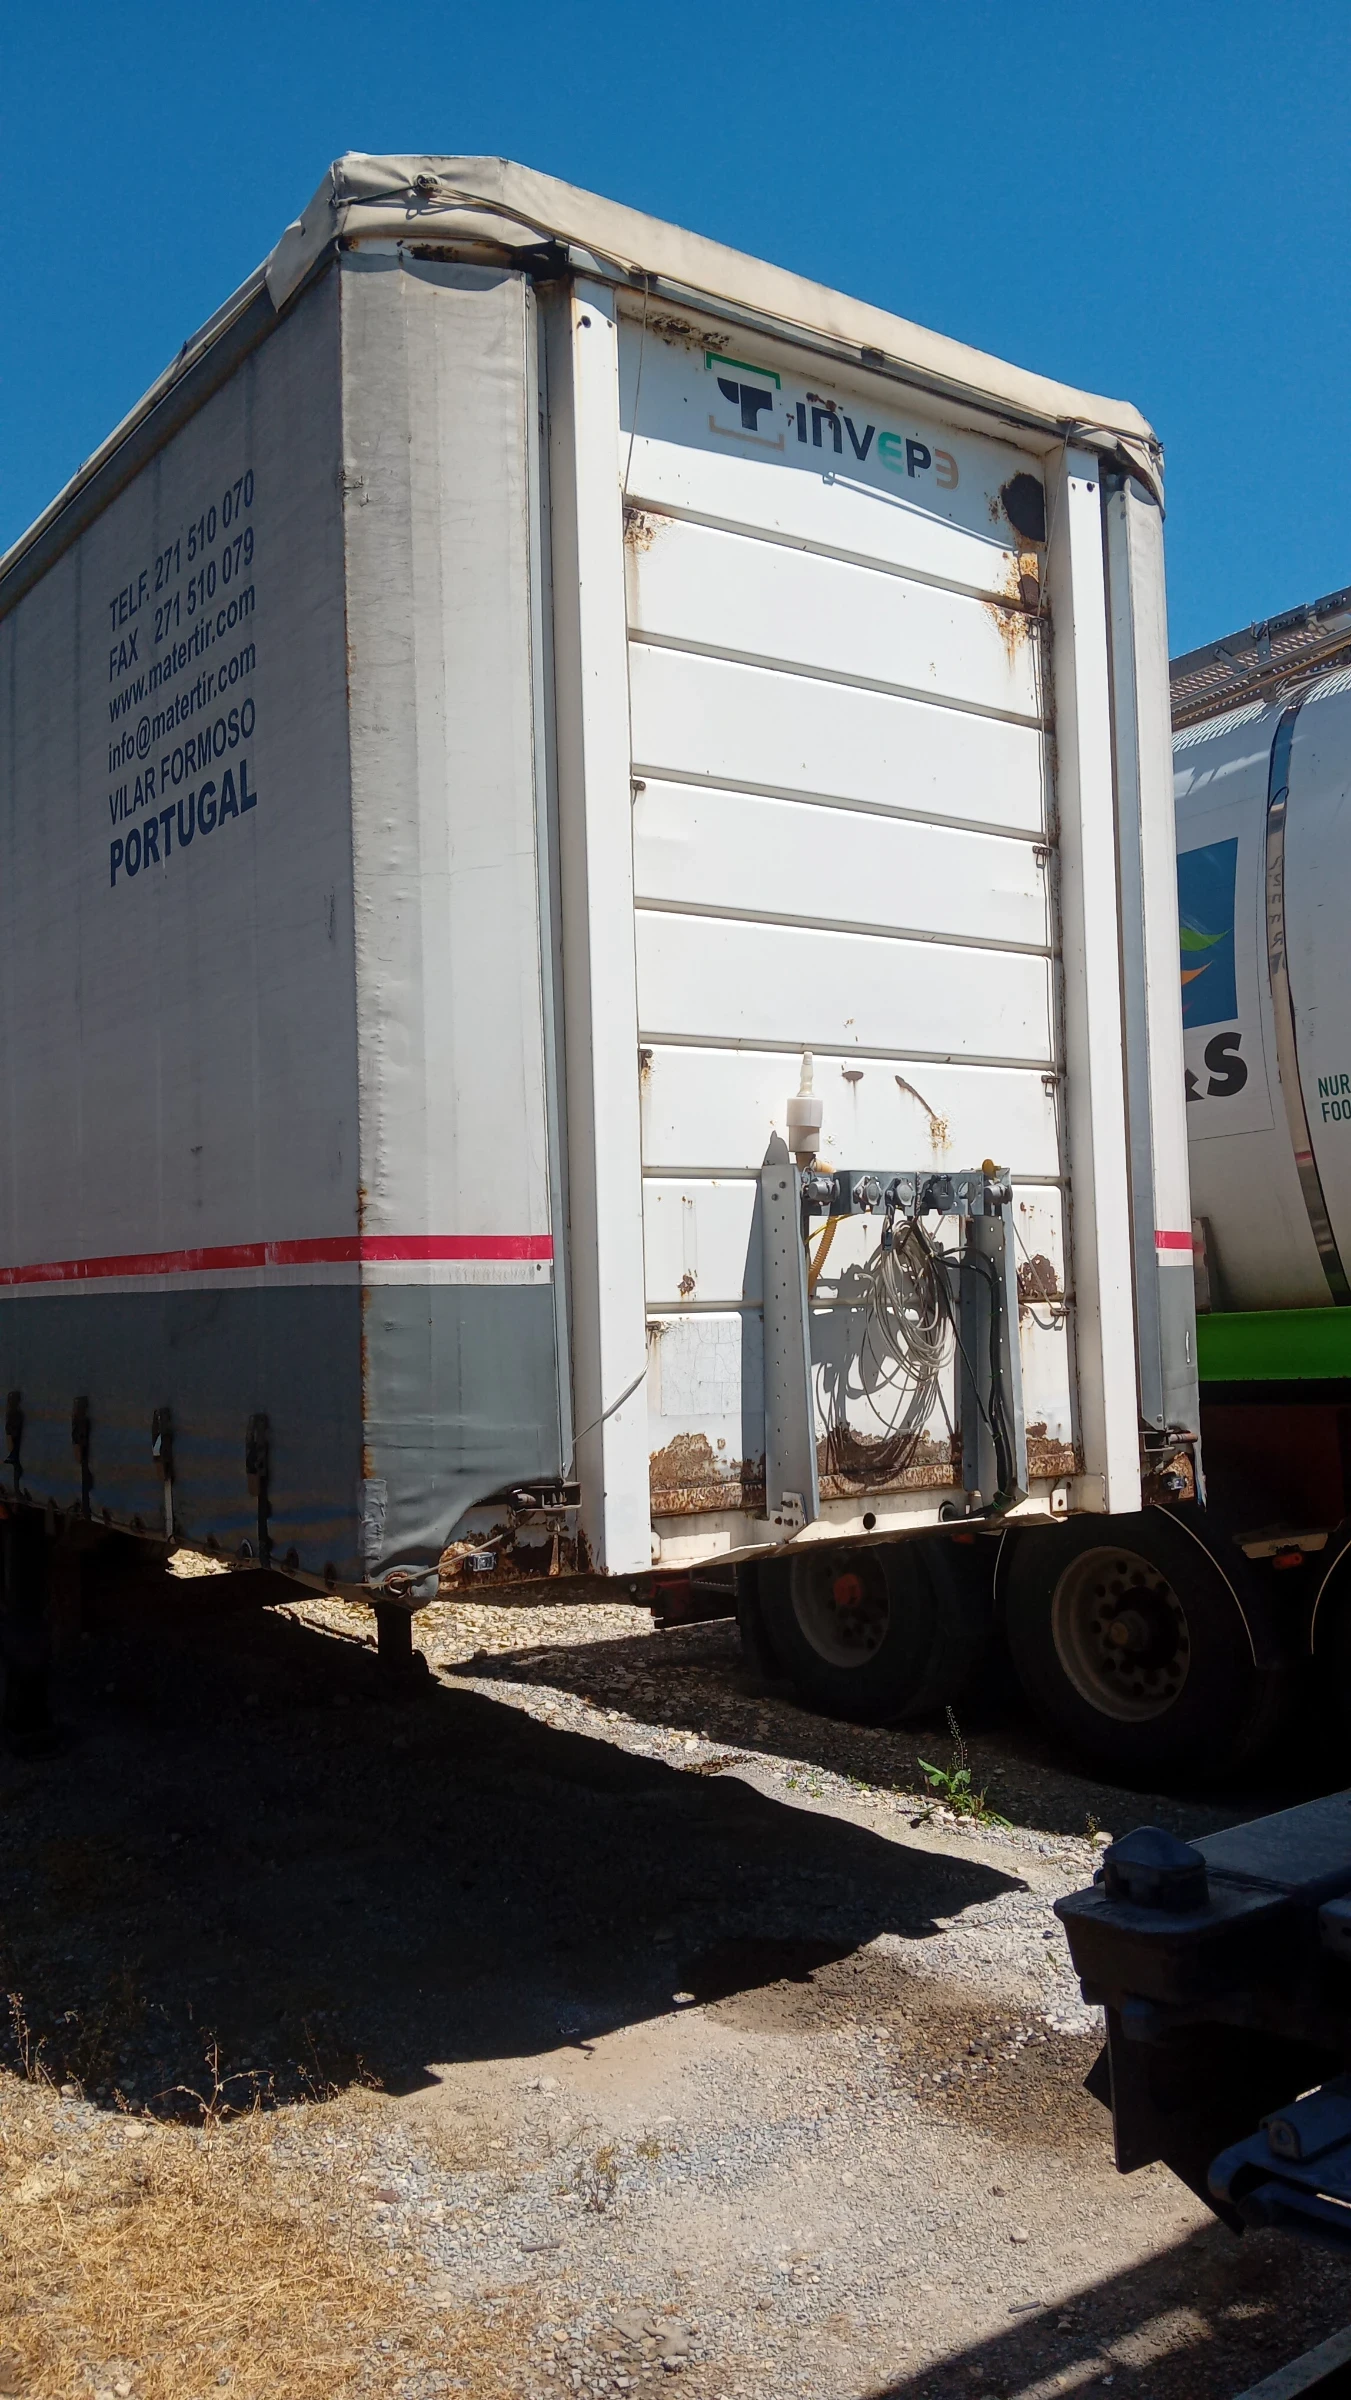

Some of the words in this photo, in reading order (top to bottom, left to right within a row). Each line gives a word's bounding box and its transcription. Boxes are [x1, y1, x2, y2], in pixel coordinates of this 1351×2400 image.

[108, 627, 138, 683] FAX
[154, 591, 180, 644] 271
[187, 560, 217, 616] 510
[222, 525, 254, 585] 079
[109, 569, 150, 632] TELF.
[154, 538, 181, 593] 271
[187, 505, 217, 562] 510
[222, 468, 254, 529] 070
[108, 585, 255, 723] www.matertir.com
[108, 642, 256, 773] info@matertir.com
[108, 766, 156, 826] VILAR
[160, 697, 256, 795] FORMOSO
[110, 758, 257, 888] PORTUGAL
